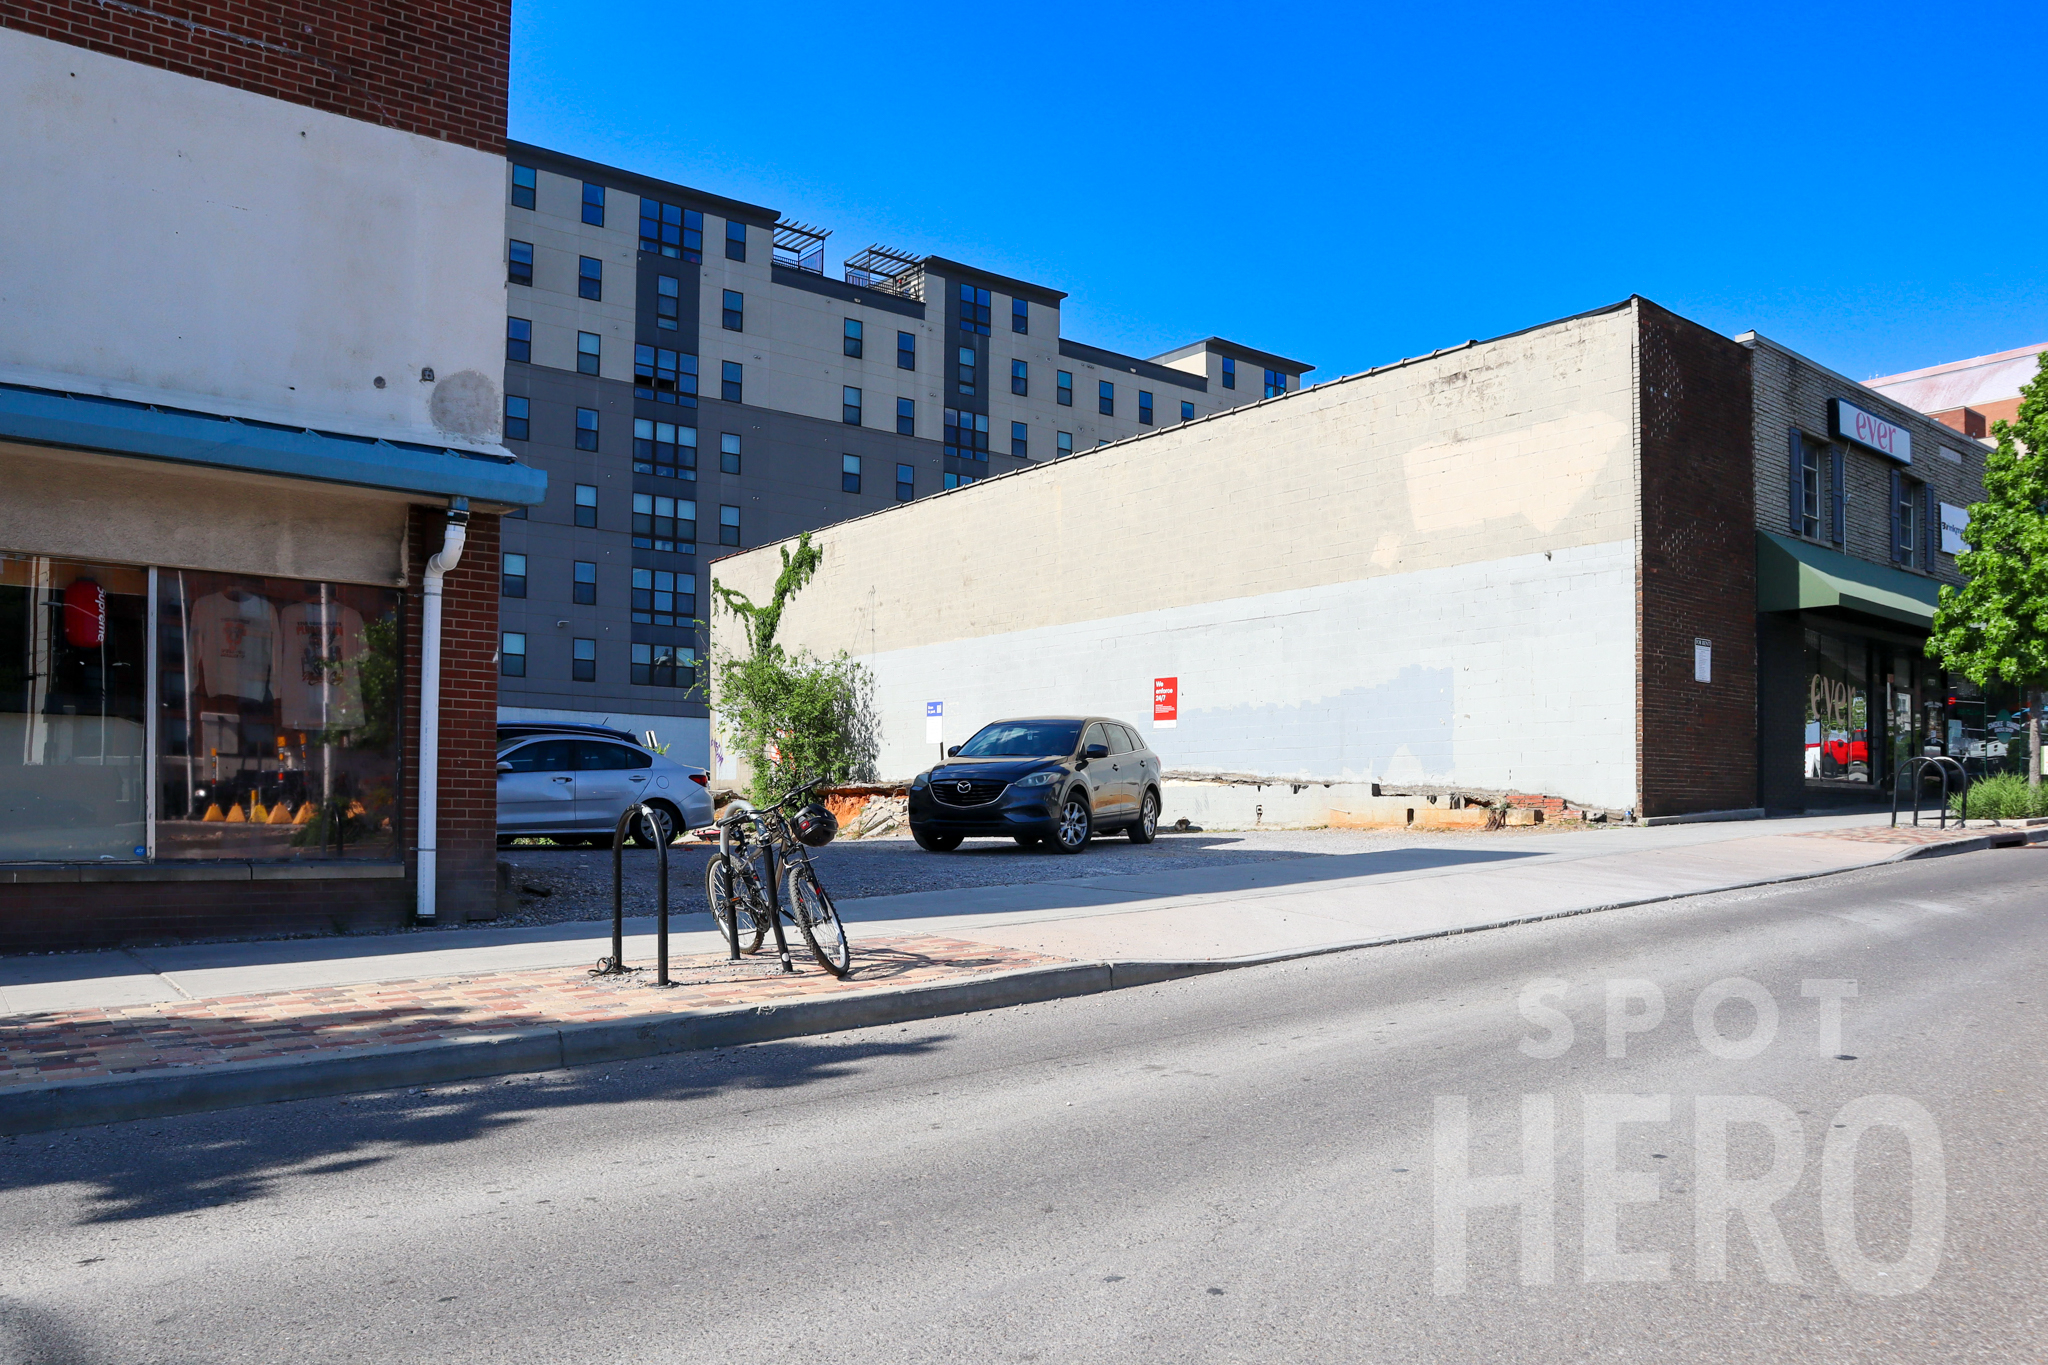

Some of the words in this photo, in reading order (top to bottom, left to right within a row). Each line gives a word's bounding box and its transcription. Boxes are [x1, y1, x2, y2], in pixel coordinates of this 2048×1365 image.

[1856, 411, 1897, 454] ever
[94, 586, 106, 642] Supreme
[1155, 694, 1166, 702] 24/7
[1810, 673, 1856, 728] ever
